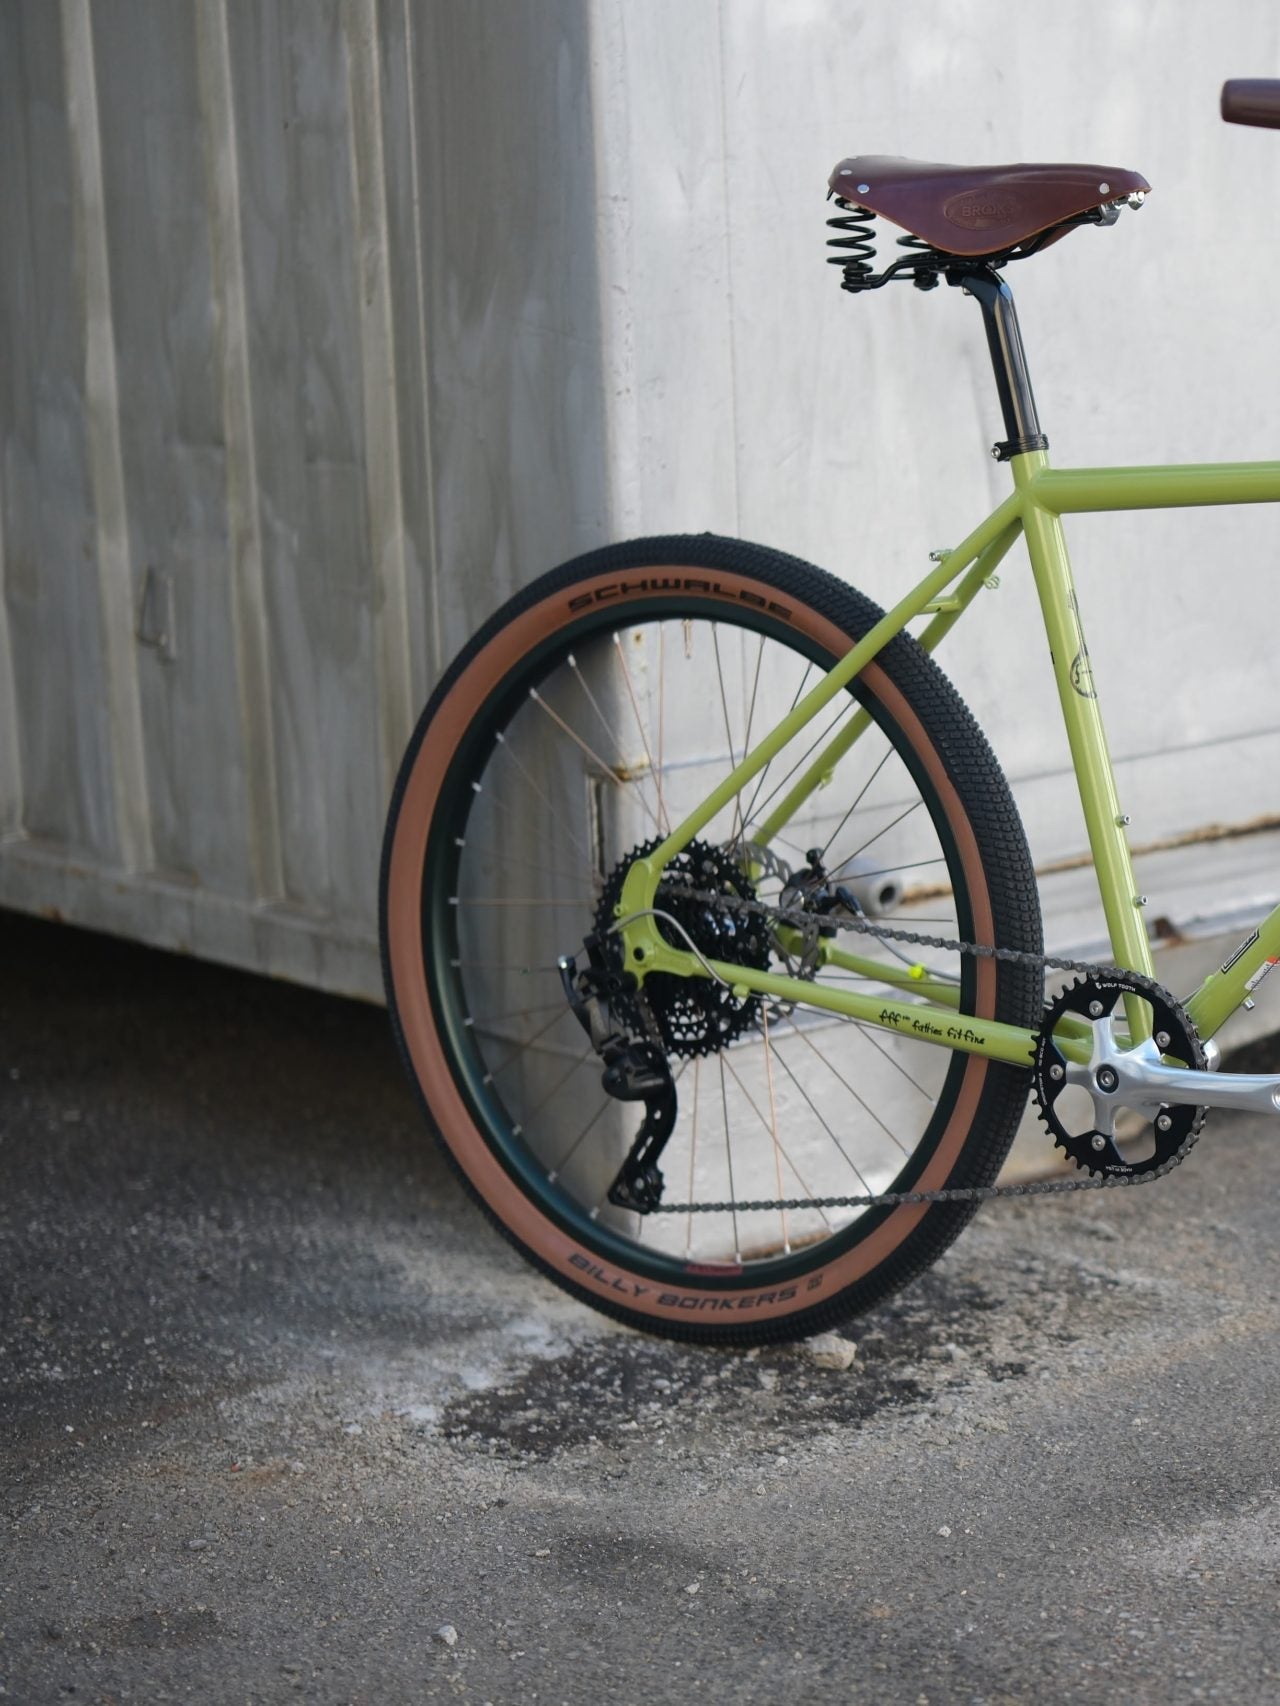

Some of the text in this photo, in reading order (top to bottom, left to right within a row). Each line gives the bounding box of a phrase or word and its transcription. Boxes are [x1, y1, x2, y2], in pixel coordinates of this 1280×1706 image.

[568, 579, 793, 620] SCHWALBE
[568, 1253, 798, 1311] BILLY BONKERS
